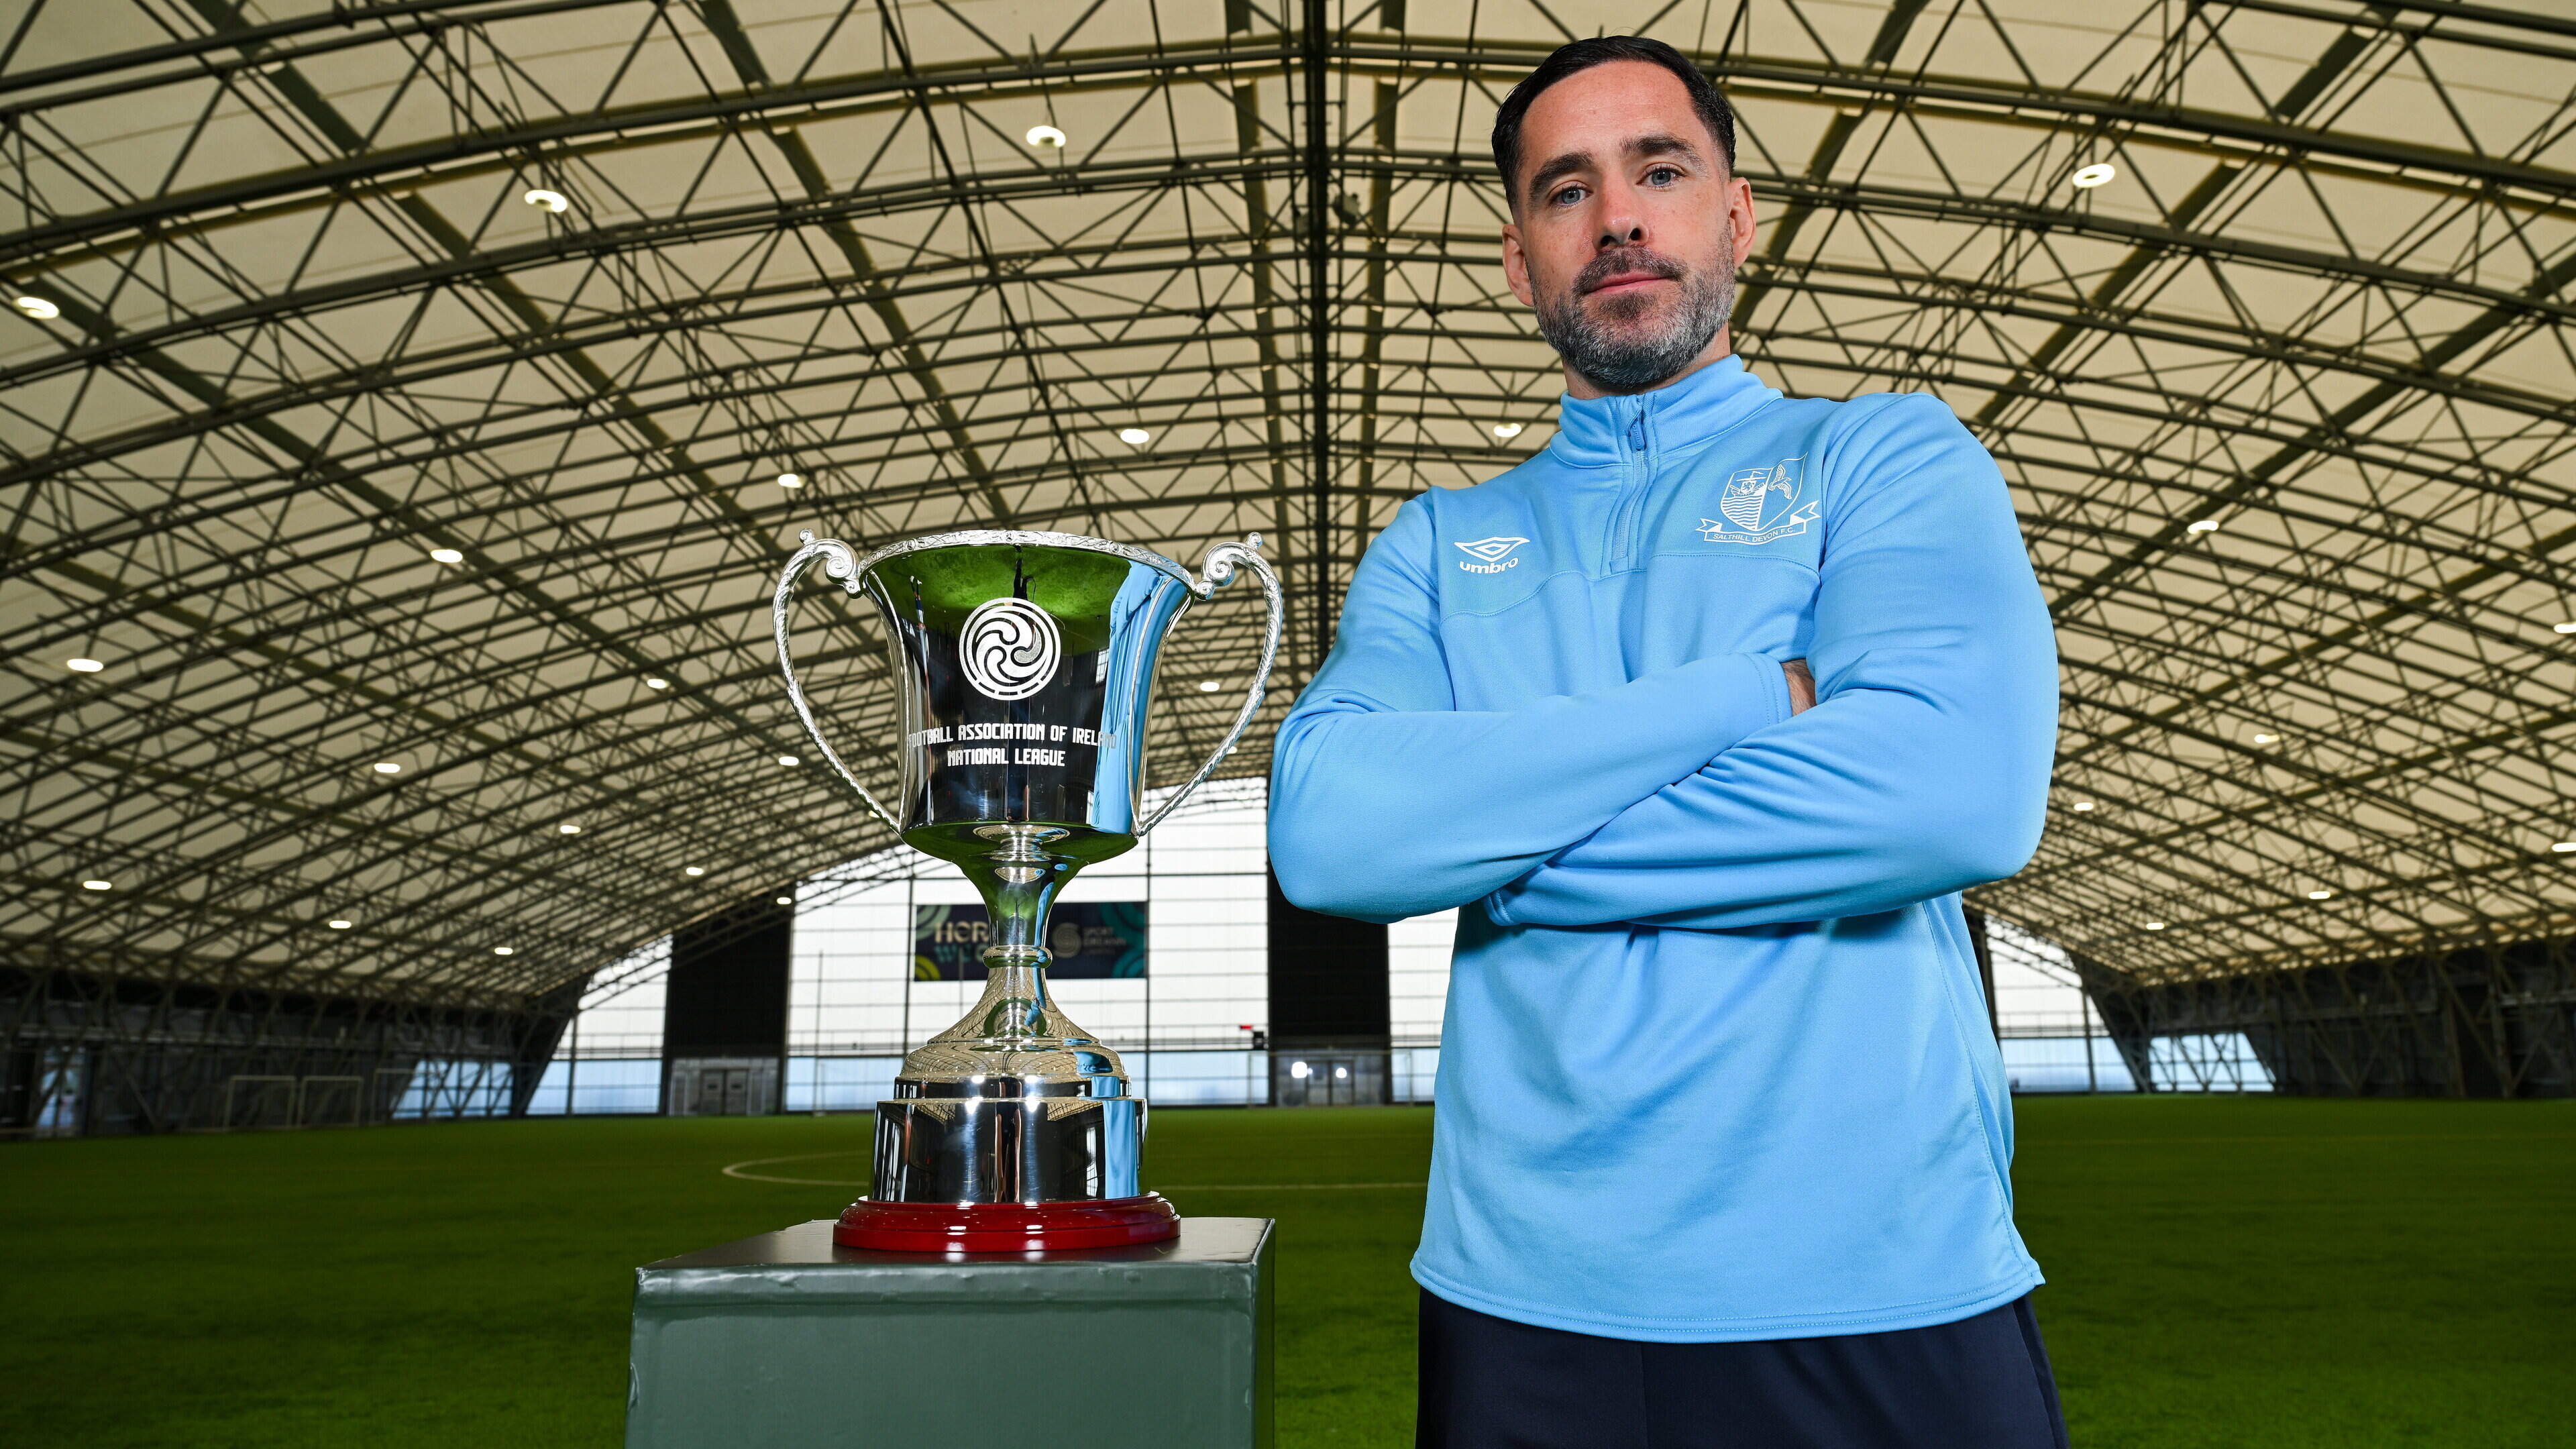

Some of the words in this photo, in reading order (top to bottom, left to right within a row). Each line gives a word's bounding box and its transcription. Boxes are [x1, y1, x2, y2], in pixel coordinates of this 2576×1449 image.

[1713, 533, 1750, 542] SALTHILL
[1752, 530, 1778, 543] DEVON
[1459, 557, 1519, 574] umbro
[908, 726, 954, 748] FOOTBALL
[957, 723, 1044, 741] ASSOCIATION
[1051, 725, 1068, 742] OF
[1072, 727, 1117, 749] IRELAND
[947, 748, 1009, 767] NATIONAL
[1014, 748, 1066, 767] LEAGUE
